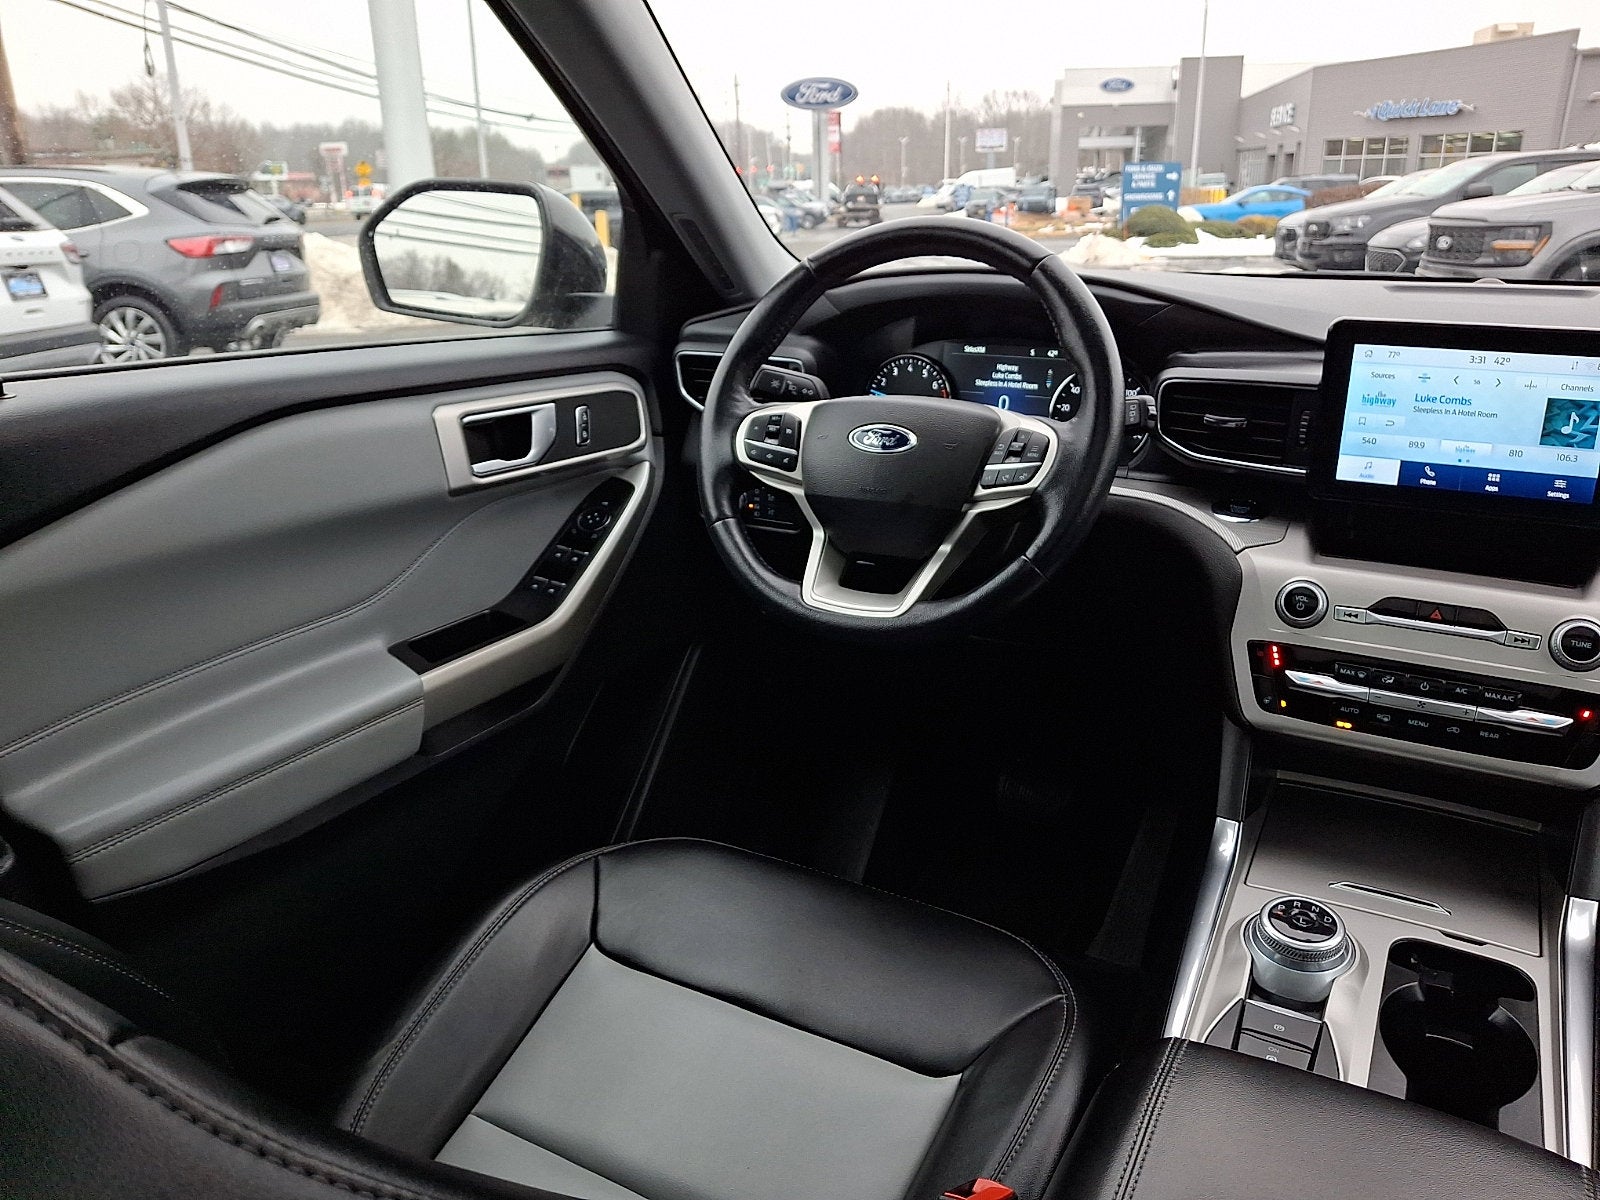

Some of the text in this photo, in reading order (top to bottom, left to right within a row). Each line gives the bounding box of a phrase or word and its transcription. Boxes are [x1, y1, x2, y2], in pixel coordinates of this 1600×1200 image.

[795, 82, 842, 104] Ford
[1378, 97, 1462, 121] Quick Lane
[1469, 355, 1486, 364] 3:31
[892, 367, 898, 376] 3
[907, 363, 913, 372] 4
[996, 363, 1019, 372] Highway
[922, 369, 928, 378] 5
[991, 371, 1022, 380] Luke Combs
[1371, 371, 1396, 380] Sources
[932, 381, 939, 390] 6
[1022, 382, 1038, 390] Room
[1071, 386, 1080, 394] 40
[1560, 383, 1594, 392] Channels
[1125, 389, 1138, 397] 100
[1361, 393, 1397, 407] highway
[1414, 393, 1472, 406] Luke Combs
[1060, 403, 1070, 411] 20
[1413, 406, 1443, 415] Sleepless
[1452, 408, 1457, 416] A
[1459, 409, 1477, 417] Hotel
[1477, 411, 1498, 419] Room
[863, 429, 900, 446] Ford
[1362, 436, 1377, 445] 540
[1408, 440, 1426, 449] 89.9
[1508, 449, 1524, 458] 810
[1556, 453, 1578, 463] 106.3
[1359, 472, 1375, 480] Audio
[1419, 478, 1437, 486] Phone
[1484, 484, 1499, 492] Apps
[1546, 490, 1570, 500] Settings
[1295, 595, 1309, 603] VOL
[1570, 639, 1592, 649] TUNE
[1340, 668, 1355, 676] MAX
[1455, 687, 1468, 695] A/C
[1484, 691, 1515, 702] MAX A/C
[1340, 706, 1359, 714] AUTO
[1407, 719, 1429, 728] MENU
[1480, 730, 1499, 739] REAR
[1323, 915, 1332, 923] D
